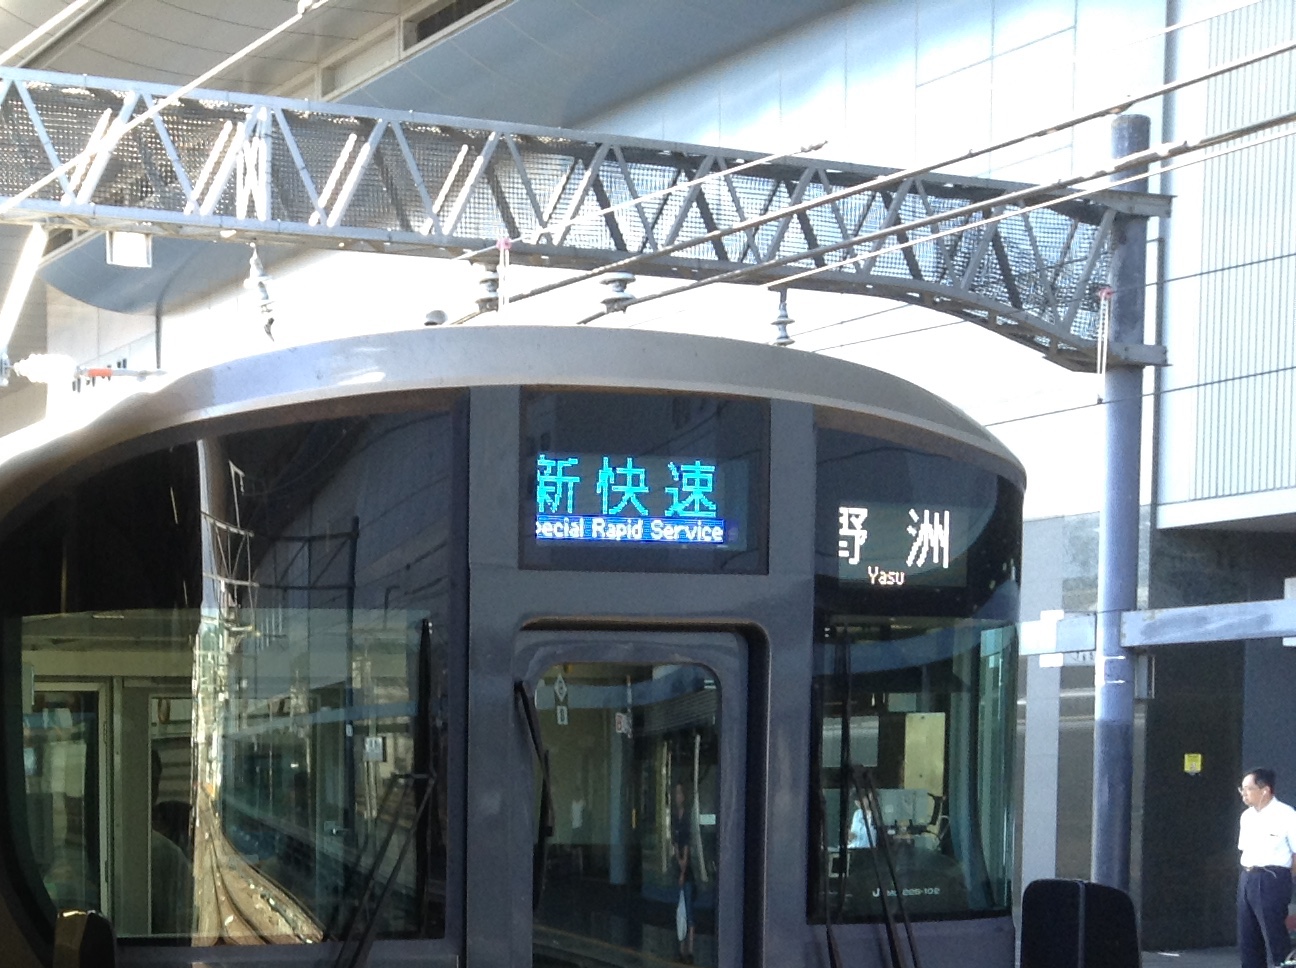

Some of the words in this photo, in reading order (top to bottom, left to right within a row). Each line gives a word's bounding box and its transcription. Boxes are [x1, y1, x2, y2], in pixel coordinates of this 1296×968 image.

[537, 455, 716, 517] 新快速
[592, 518, 643, 540] Rapid
[651, 519, 723, 541] Service
[839, 507, 950, 568] 野洲
[867, 566, 904, 585] Yasu
